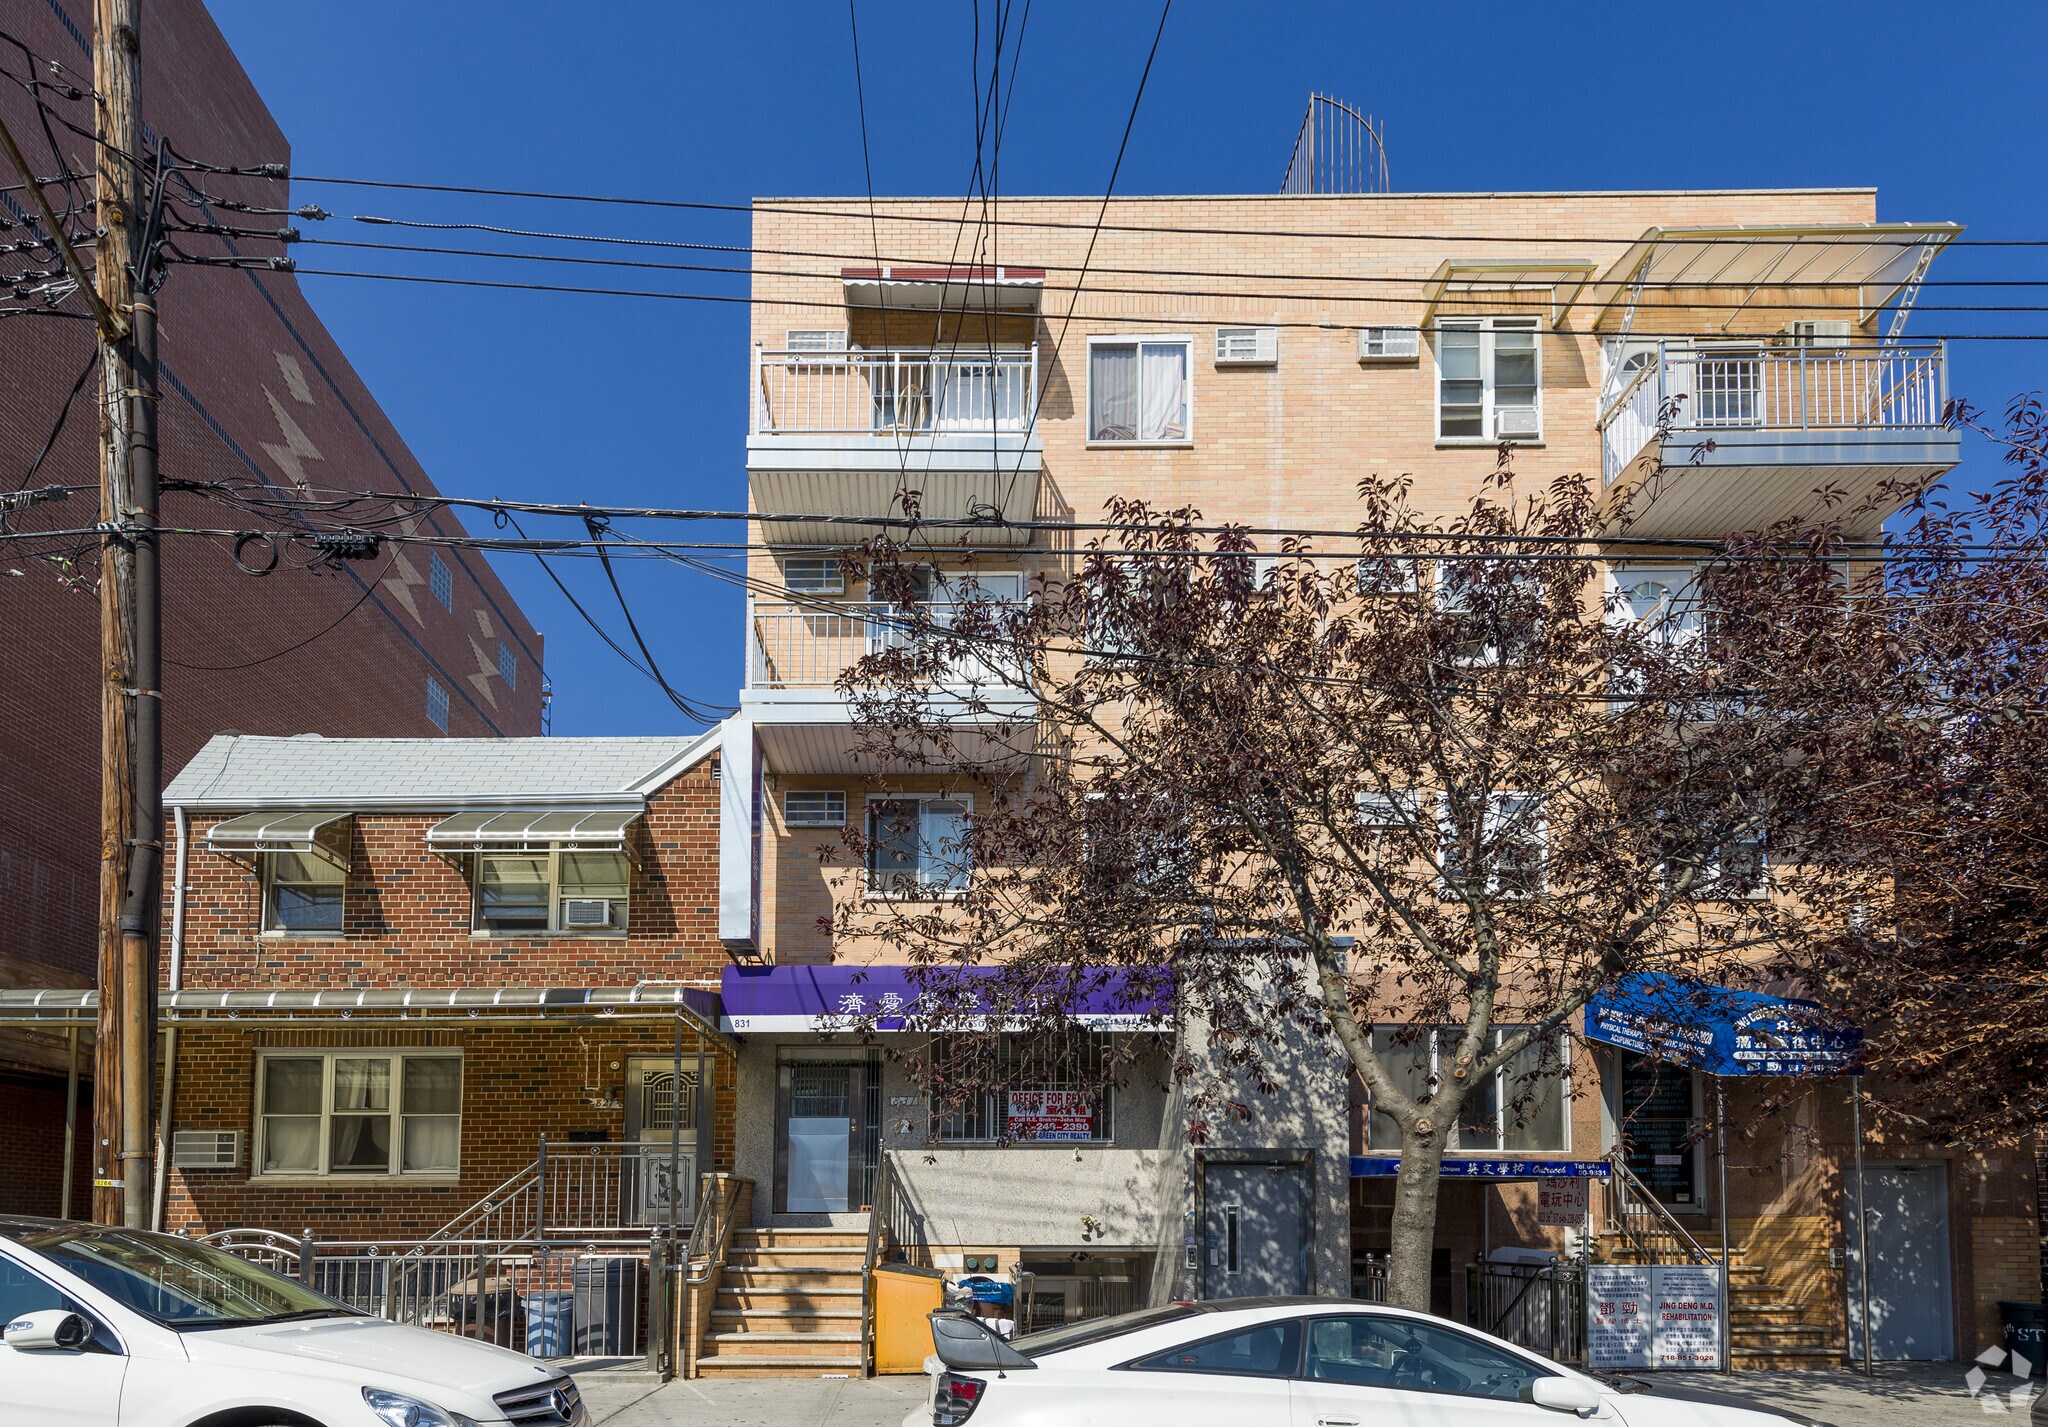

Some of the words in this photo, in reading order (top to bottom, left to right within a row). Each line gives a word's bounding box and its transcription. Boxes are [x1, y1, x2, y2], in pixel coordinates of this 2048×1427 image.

[735, 1019, 750, 1028] 831
[1600, 1021, 1621, 1034] PHYSICAL
[1012, 1092, 1044, 1105] OFFICE
[1046, 1092, 1063, 1104] FOR
[1066, 1092, 1088, 1104] REN
[1533, 1165, 1567, 1174] Outreach
[1540, 1192, 1584, 1208] 電玩中心
[1600, 1302, 1638, 1315] 鄧勁
[1659, 1302, 1676, 1310] JING
[1678, 1302, 1698, 1310] DENG
[1700, 1302, 1715, 1310] M.D.
[1662, 1313, 1712, 1321] REHABILITATION
[2018, 1328, 2045, 1342] ST
